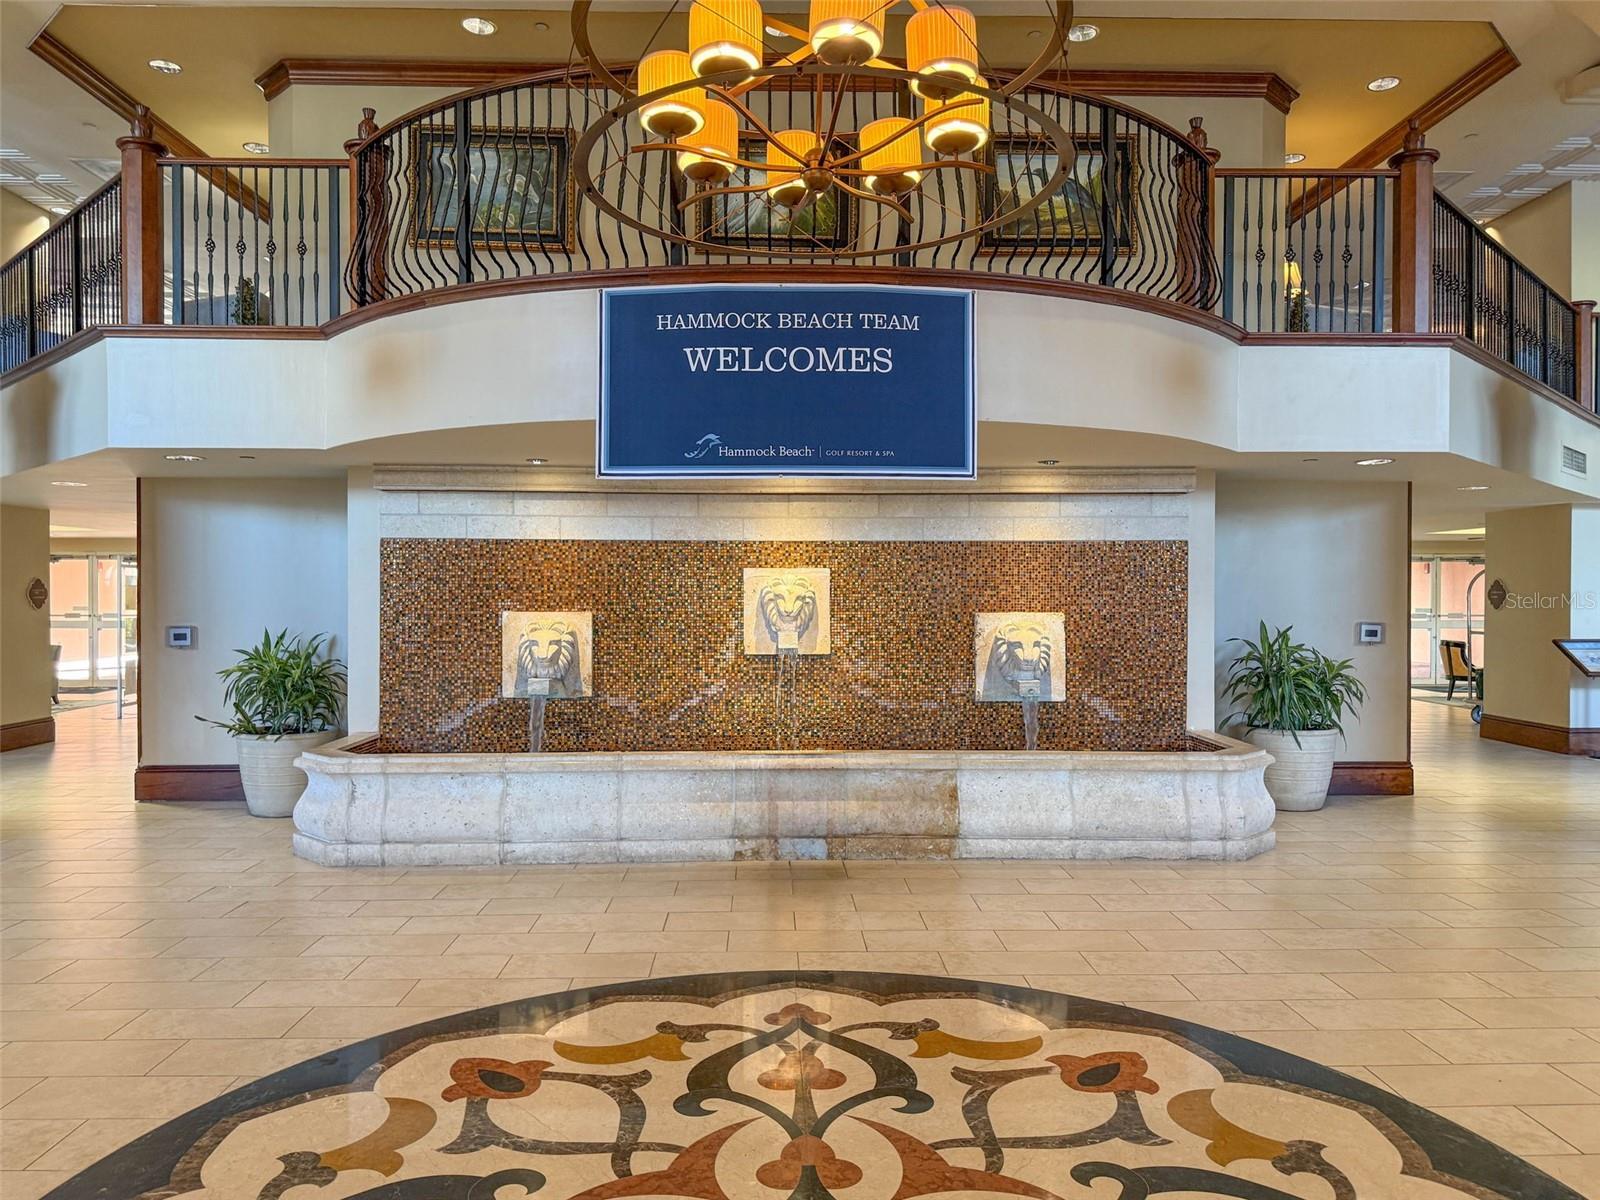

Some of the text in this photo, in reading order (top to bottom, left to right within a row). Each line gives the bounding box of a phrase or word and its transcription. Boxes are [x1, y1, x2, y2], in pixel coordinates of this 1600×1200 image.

[656, 313, 920, 331] HAMMOCK BEACH TEAM
[683, 346, 893, 373] WELCOMES
[718, 445, 812, 457] Hammock Beach
